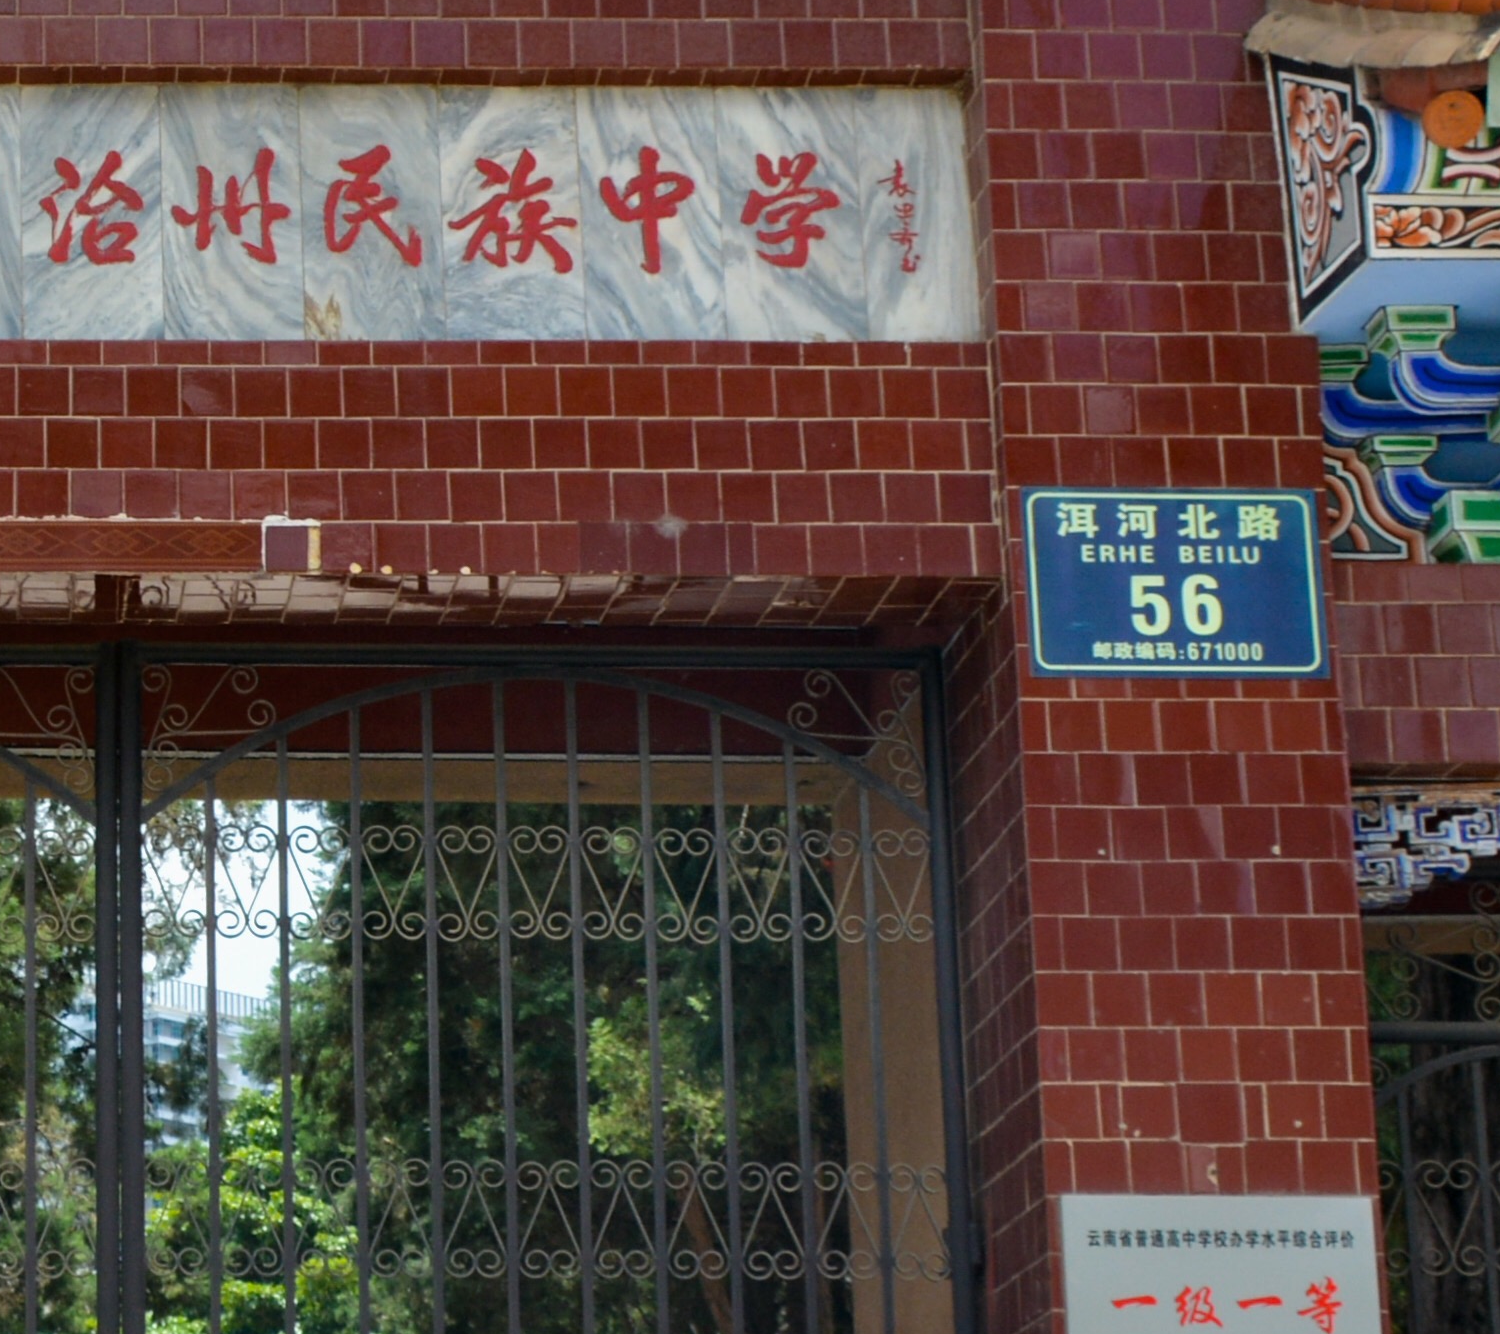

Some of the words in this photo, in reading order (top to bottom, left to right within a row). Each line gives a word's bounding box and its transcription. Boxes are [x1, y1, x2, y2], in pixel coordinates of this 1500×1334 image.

[1056, 502, 1281, 542] 洱河北路
[1080, 544, 1156, 564] ERHE
[1178, 545, 1261, 565] BEILU
[1130, 573, 1224, 637] 56
[1086, 1228, 1355, 1249] 云南省普通高中学校办学水平综合评价
